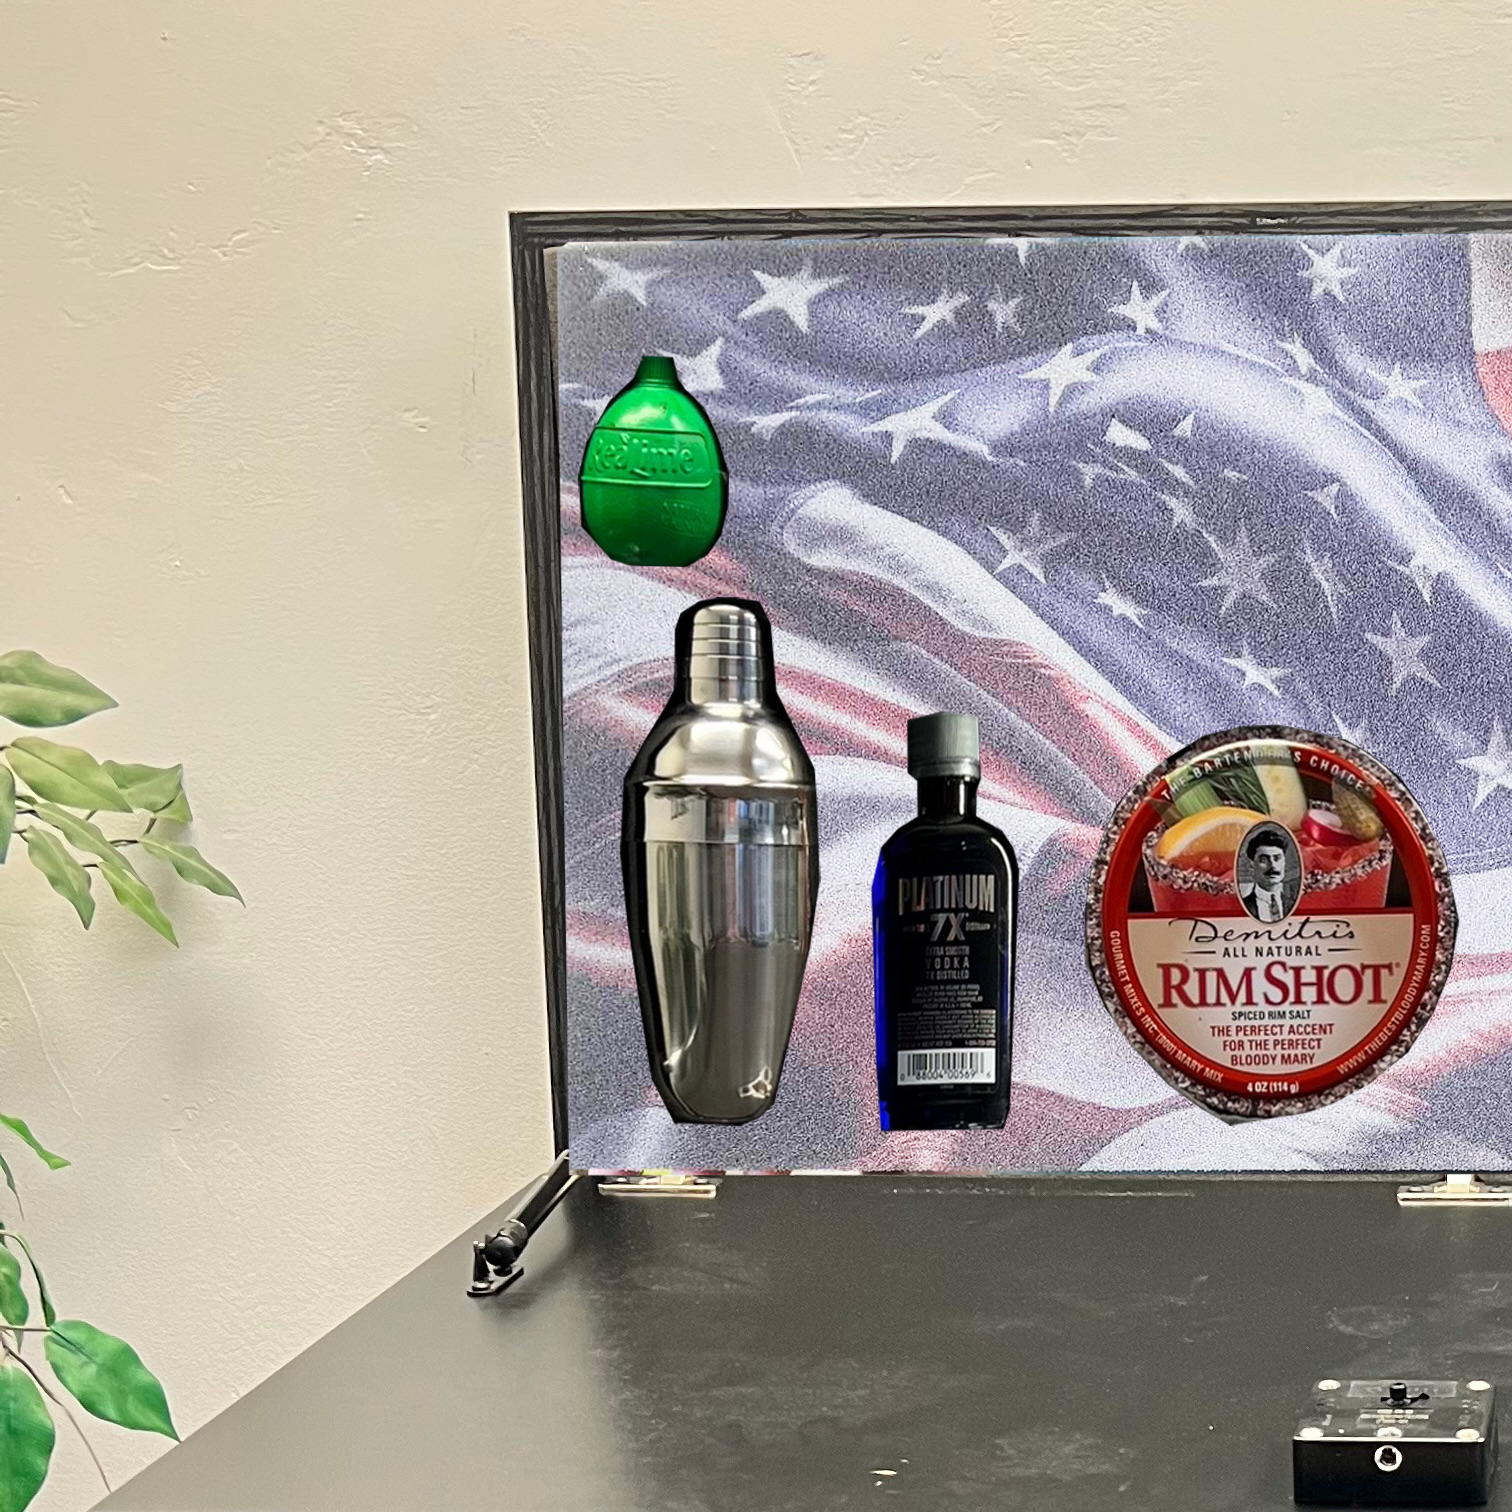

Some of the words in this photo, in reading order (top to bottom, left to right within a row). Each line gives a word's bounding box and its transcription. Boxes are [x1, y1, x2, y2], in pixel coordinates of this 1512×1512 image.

[1160, 776, 1189, 800] THE
[1309, 755, 1366, 791] CHOICE
[899, 873, 995, 915] PLATINUM
[930, 912, 966, 942] 7X
[1222, 946, 1247, 958] ALL
[1255, 945, 1322, 957] NATURAL
[925, 956, 970, 969] VODKA
[936, 969, 970, 980] DISTILLED
[1157, 962, 1257, 1008] RIM
[1262, 960, 1395, 1007] SHOT
[1109, 930, 1130, 983] GOURMET
[1123, 983, 1145, 1017] MIXES
[1175, 1049, 1204, 1073] MARY
[1202, 1066, 1225, 1084] MIX
[1231, 1010, 1265, 1022] SPICED
[1267, 1010, 1287, 1021] RIM
[1288, 1009, 1312, 1020] SALT
[1209, 1025, 1232, 1037] THE
[1235, 1023, 1285, 1037] PERFECT
[1287, 1023, 1335, 1036] ACCENT
[1222, 1039, 1245, 1051] FOR
[1247, 1039, 1270, 1051] THE
[1273, 1038, 1323, 1050] PERFECT
[1230, 1053, 1278, 1066] BLOODY
[1280, 1052, 1316, 1065] MARY
[1246, 1082, 1253, 1092] 4
[1254, 1081, 1268, 1092] OZ
[1269, 1081, 1289, 1093] (114
[1289, 1081, 1300, 1094] g)
